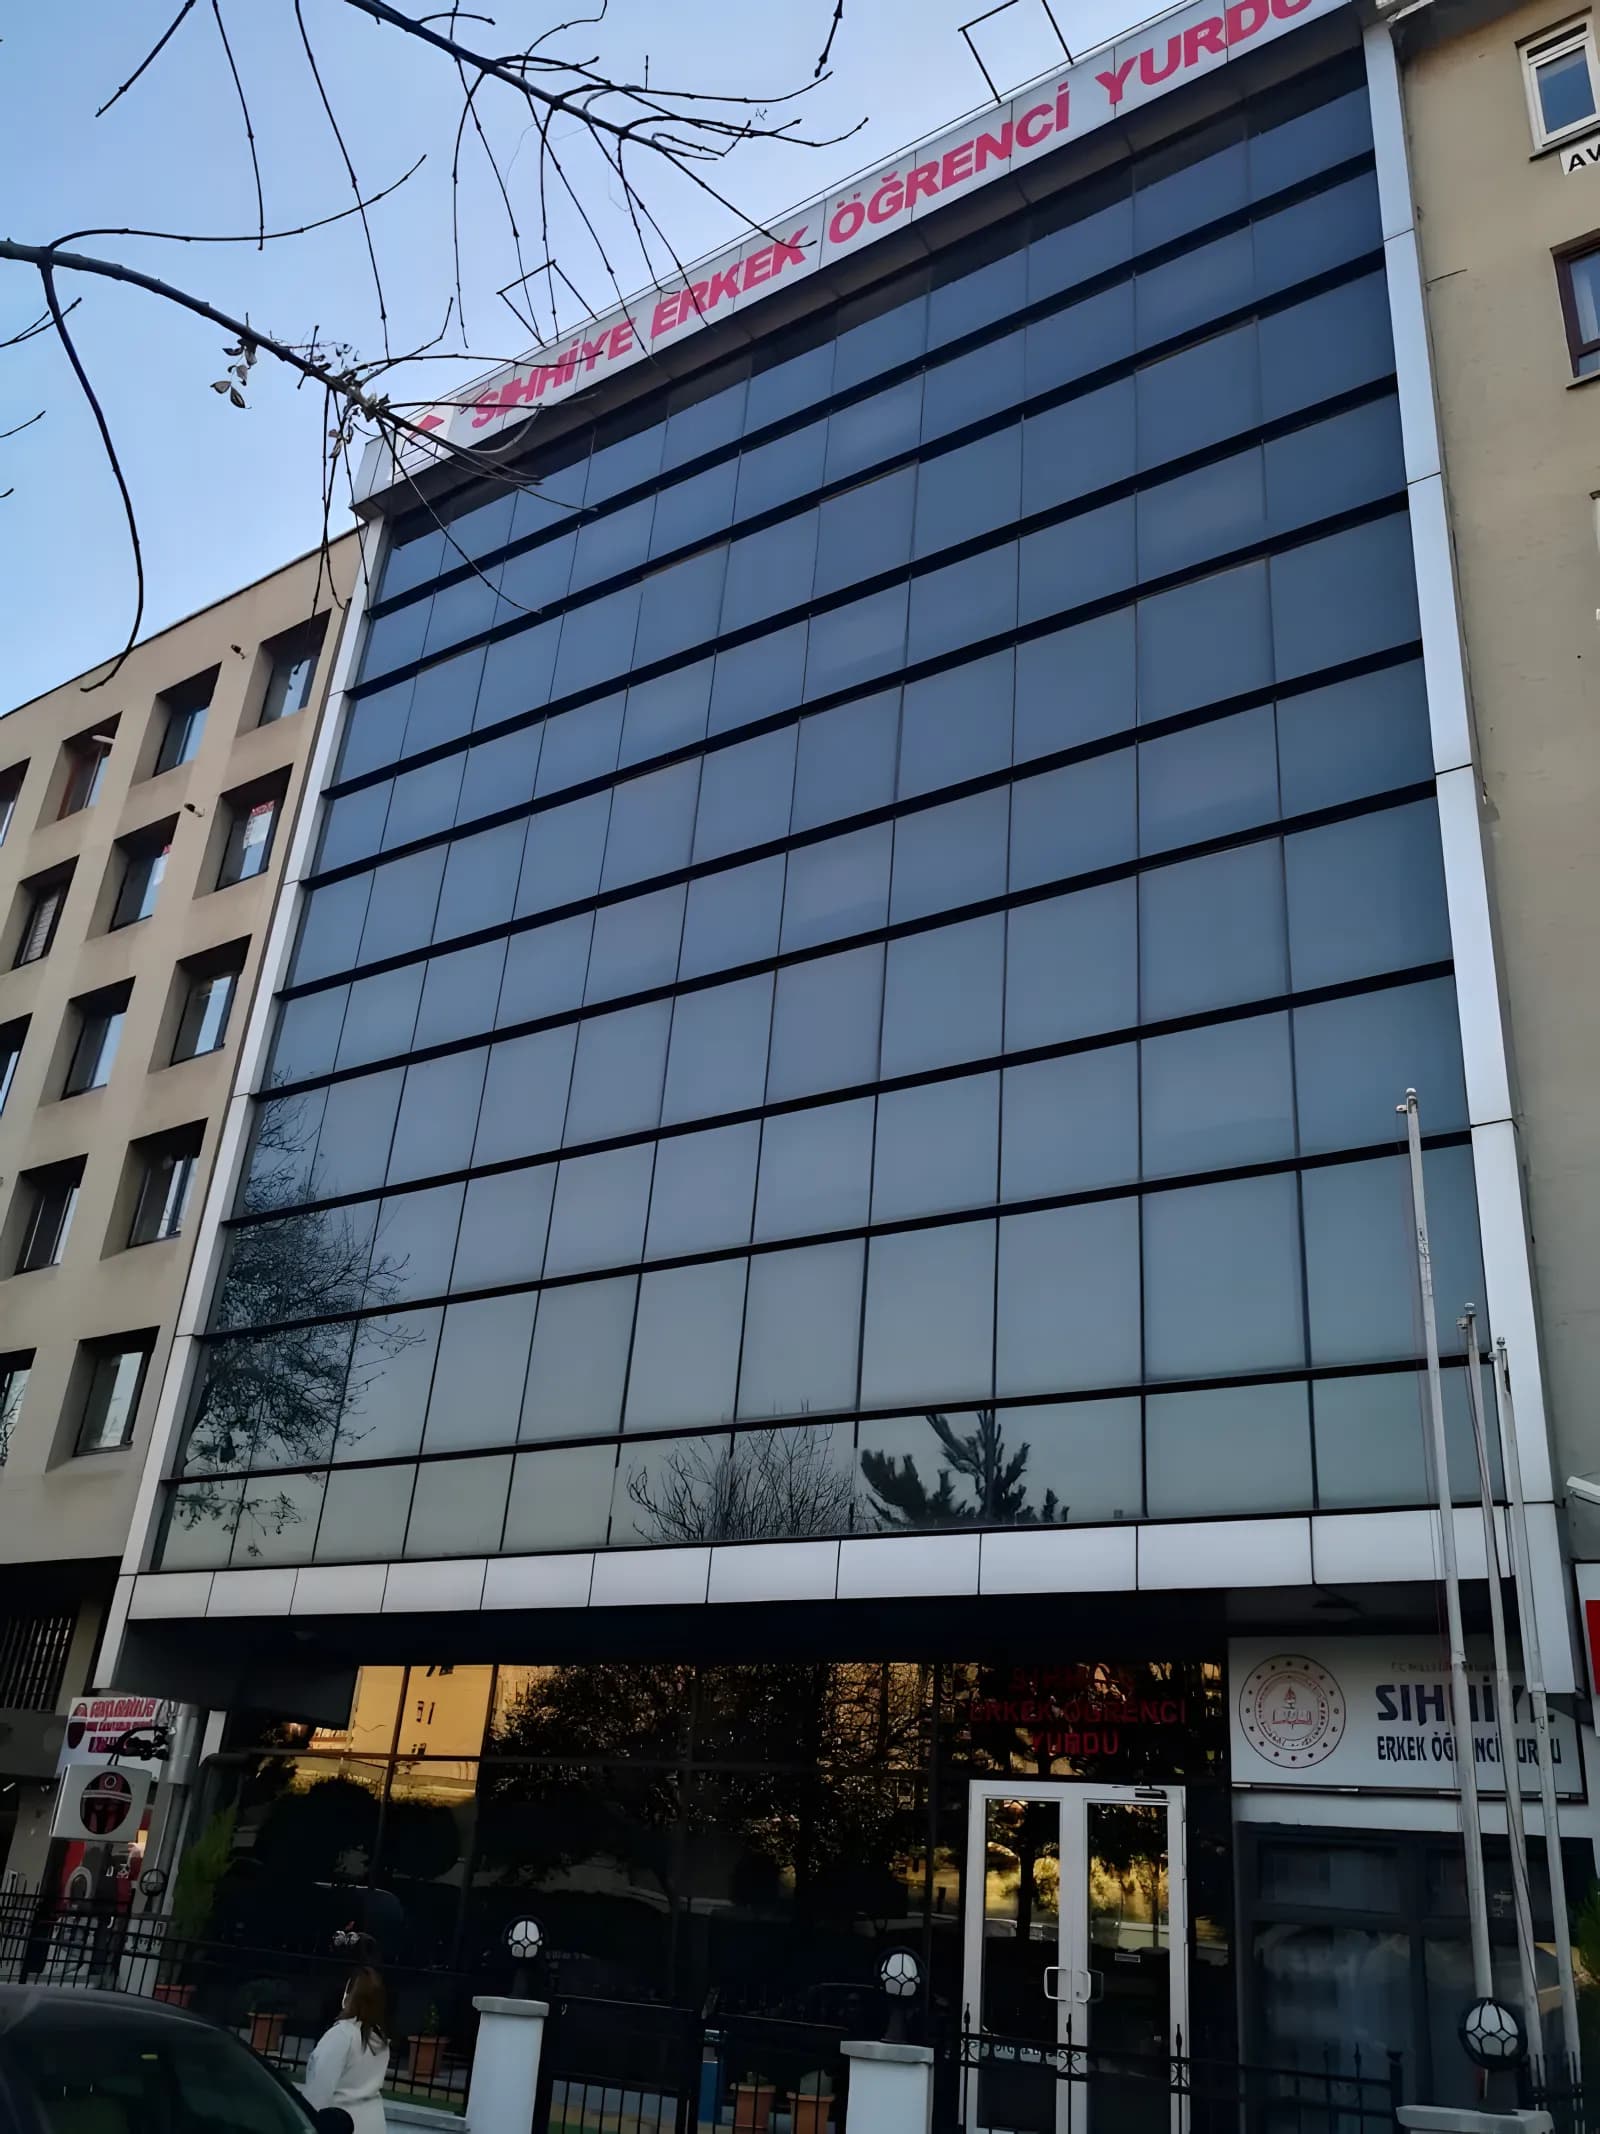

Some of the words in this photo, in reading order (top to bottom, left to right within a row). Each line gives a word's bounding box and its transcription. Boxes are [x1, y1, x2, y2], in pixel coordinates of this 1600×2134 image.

[650, 226, 810, 340] ERKEK
[828, 82, 1071, 244] ÖĞRENCİ
[1377, 1735, 1426, 1763] ERKEK
[1432, 1731, 1500, 1763] ÖĞNCİ
[1512, 1737, 1562, 1767] URU
